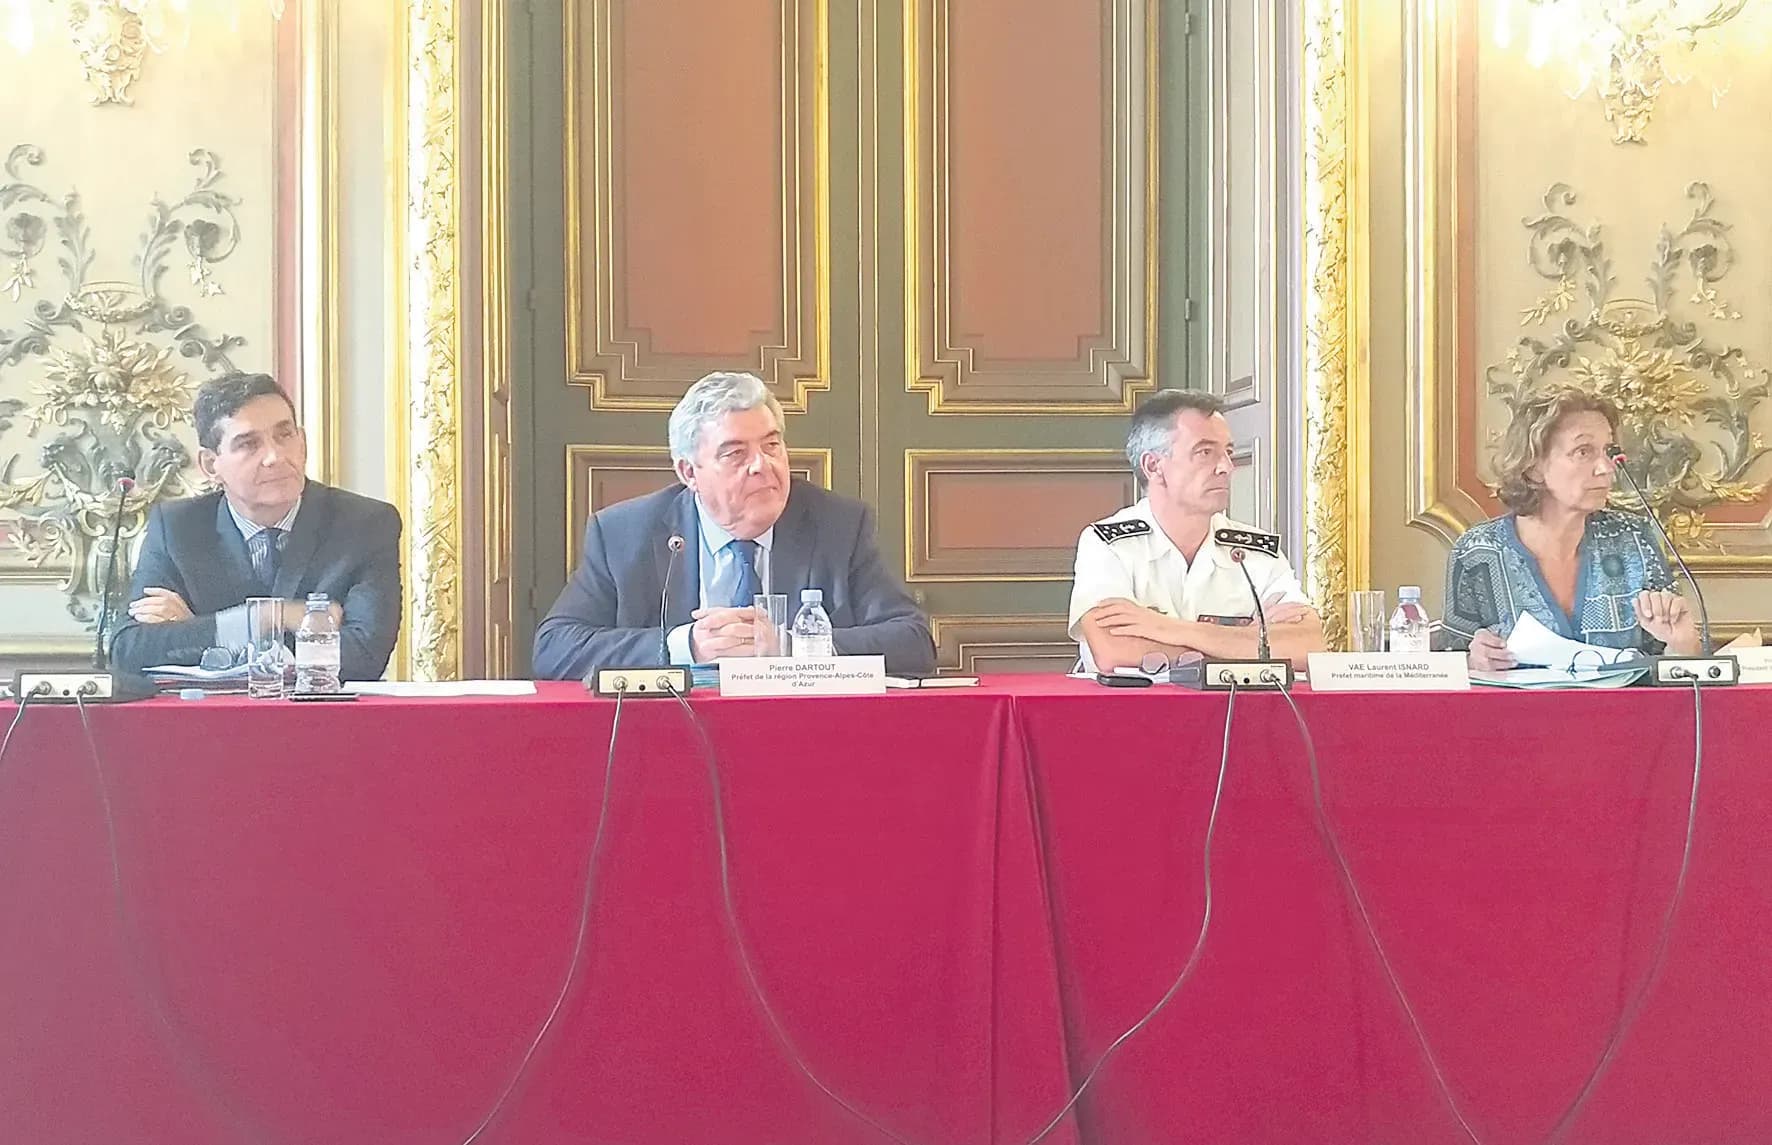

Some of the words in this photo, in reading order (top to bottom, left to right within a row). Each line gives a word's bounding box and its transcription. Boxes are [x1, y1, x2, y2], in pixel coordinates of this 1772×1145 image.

[769, 664, 793, 672] Pierre
[795, 663, 836, 671] DARTOUT
[731, 672, 753, 680] Préfet
[754, 672, 764, 680] de
[765, 672, 772, 680] la
[773, 672, 797, 681] région
[798, 671, 874, 680] Provence-Alpes-Côte
